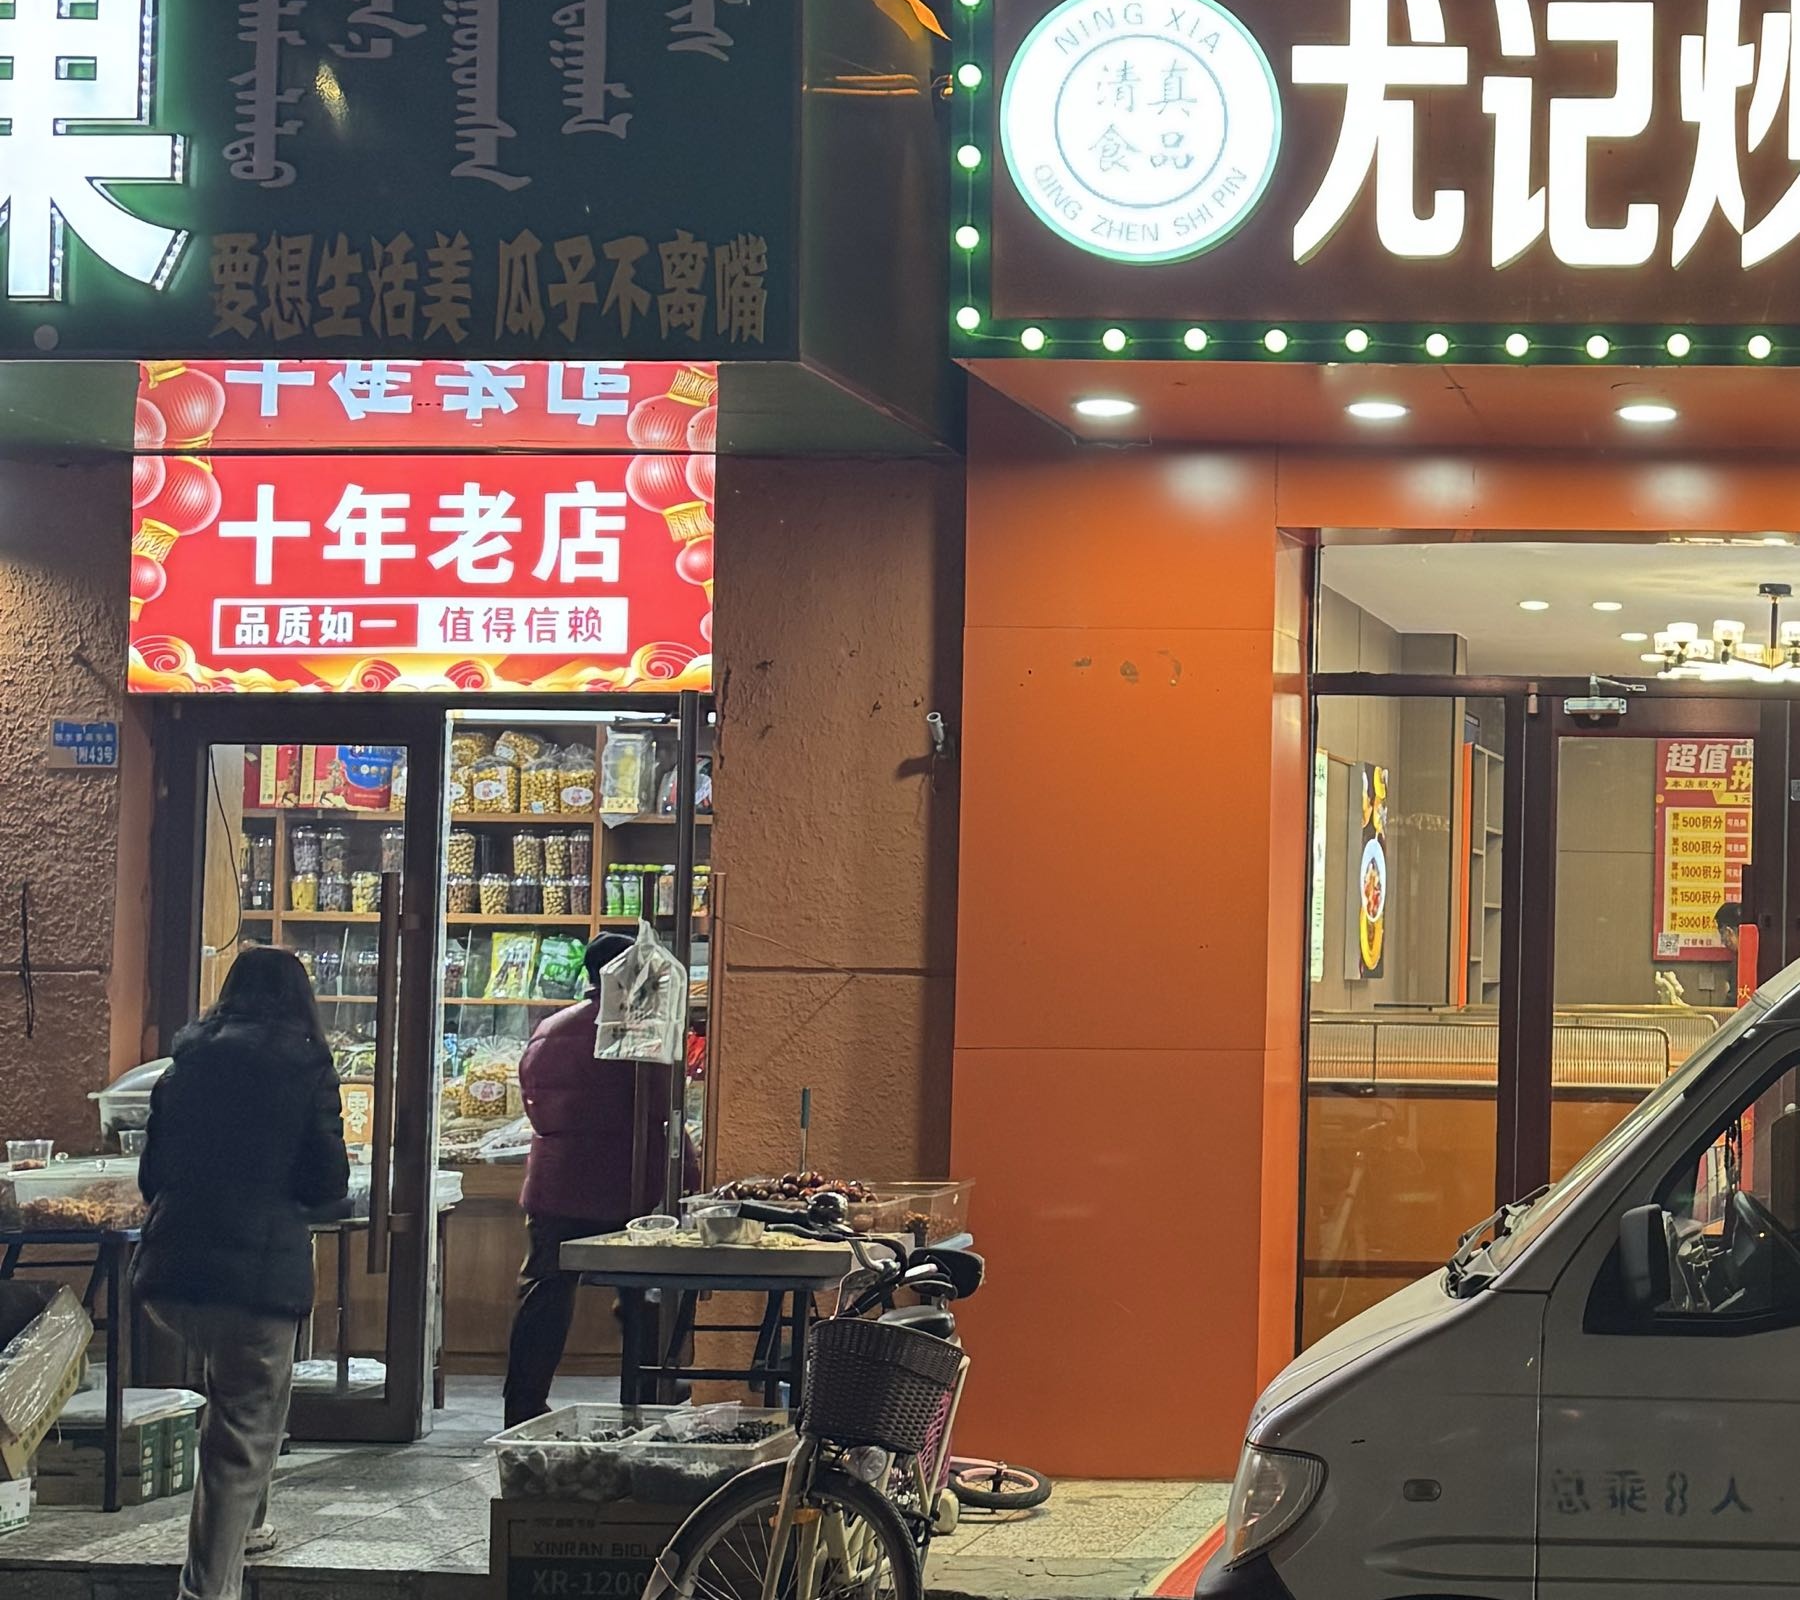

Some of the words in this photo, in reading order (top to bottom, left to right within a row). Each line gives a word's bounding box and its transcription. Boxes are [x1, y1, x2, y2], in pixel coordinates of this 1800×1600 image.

[1054, 2, 1144, 55] NING
[1164, 7, 1222, 55] XIA
[1096, 59, 1198, 116] 清真
[1087, 123, 1194, 173] 食品
[1034, 163, 1084, 221] QING
[1090, 215, 1160, 241] ZHEN
[1172, 207, 1215, 237] SHI
[1211, 166, 1248, 208] PIN
[208, 230, 473, 344] 要想生活美
[494, 229, 768, 344] 瓜子不离嘴
[218, 481, 628, 585] 十年老店
[234, 606, 397, 646] 品质如一
[438, 605, 602, 644] 值得信赖
[1665, 743, 1730, 773] 超值
[1682, 815, 1723, 830] 500积分
[1681, 839, 1722, 855] 800积分
[1681, 862, 1722, 879] 1000积分
[1680, 891, 1722, 904] 1500积分
[1678, 916, 1717, 929] 3000积
[532, 1540, 603, 1556] XINRAN
